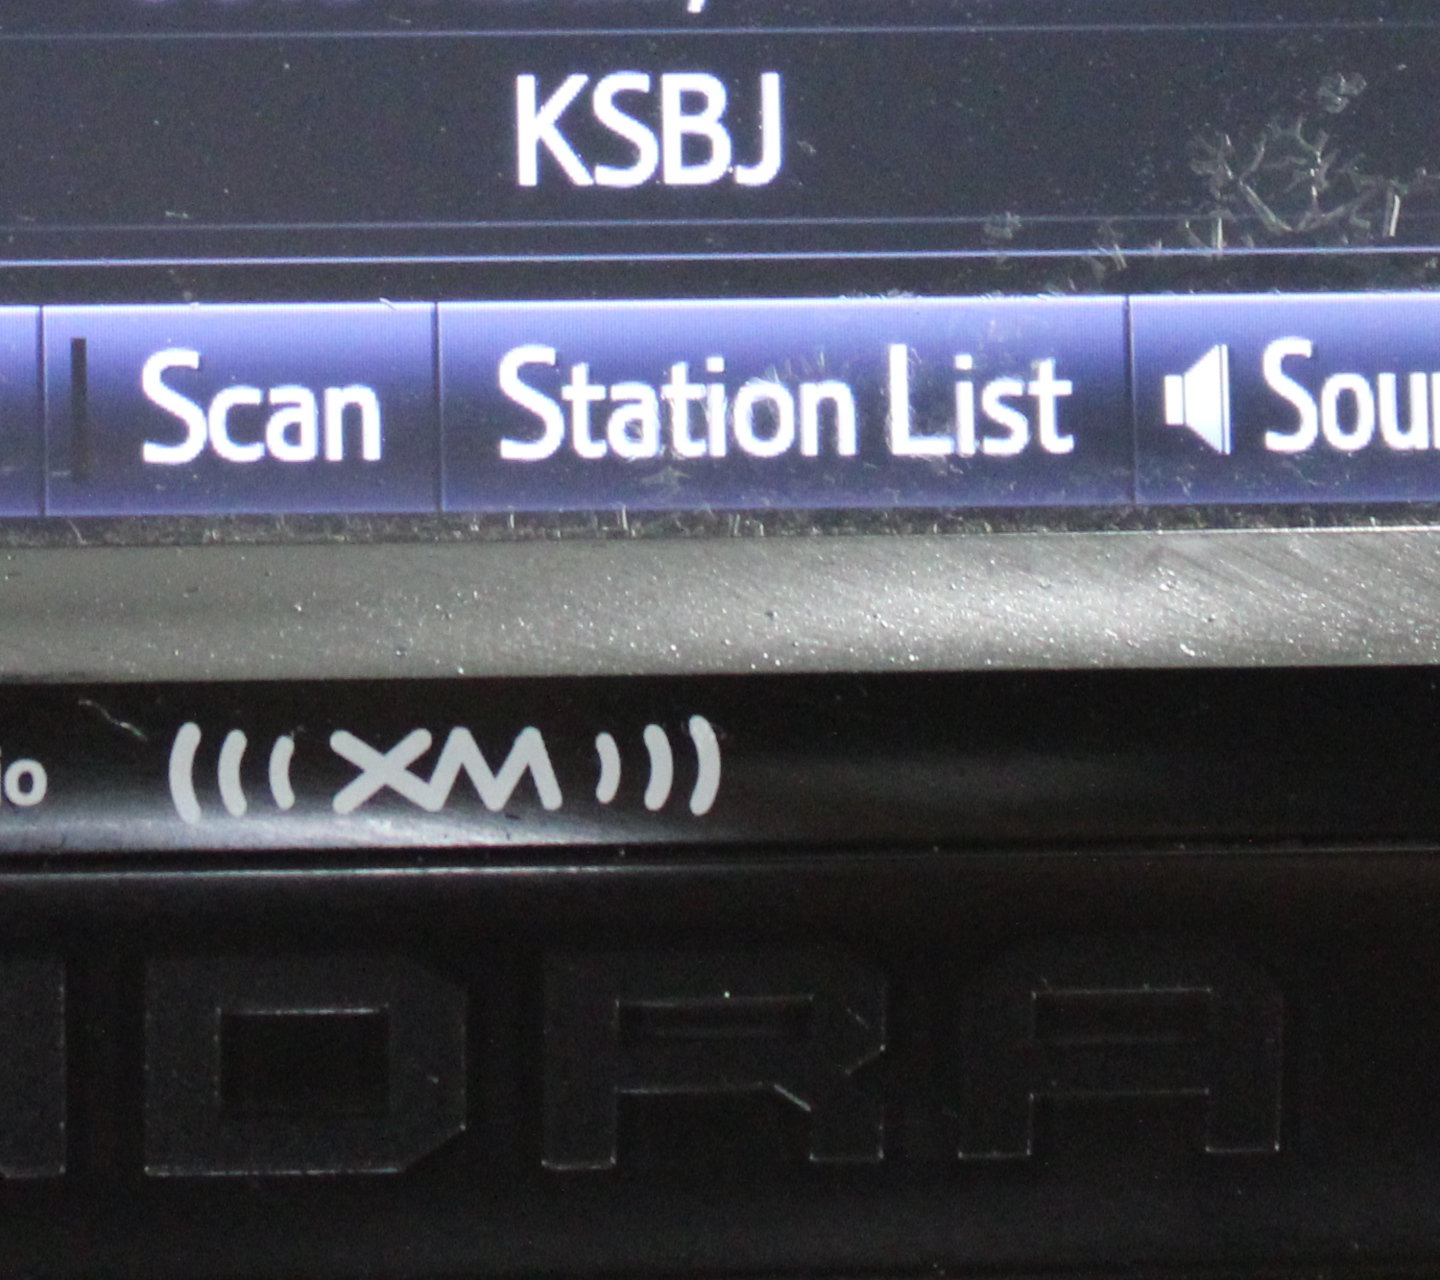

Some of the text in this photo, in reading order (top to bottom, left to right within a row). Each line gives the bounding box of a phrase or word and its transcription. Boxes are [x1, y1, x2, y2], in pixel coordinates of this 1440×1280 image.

[515, 70, 783, 189] KSBJ
[141, 347, 381, 464] Scan
[498, 343, 1074, 460] Station List
[329, 726, 564, 814] XM
